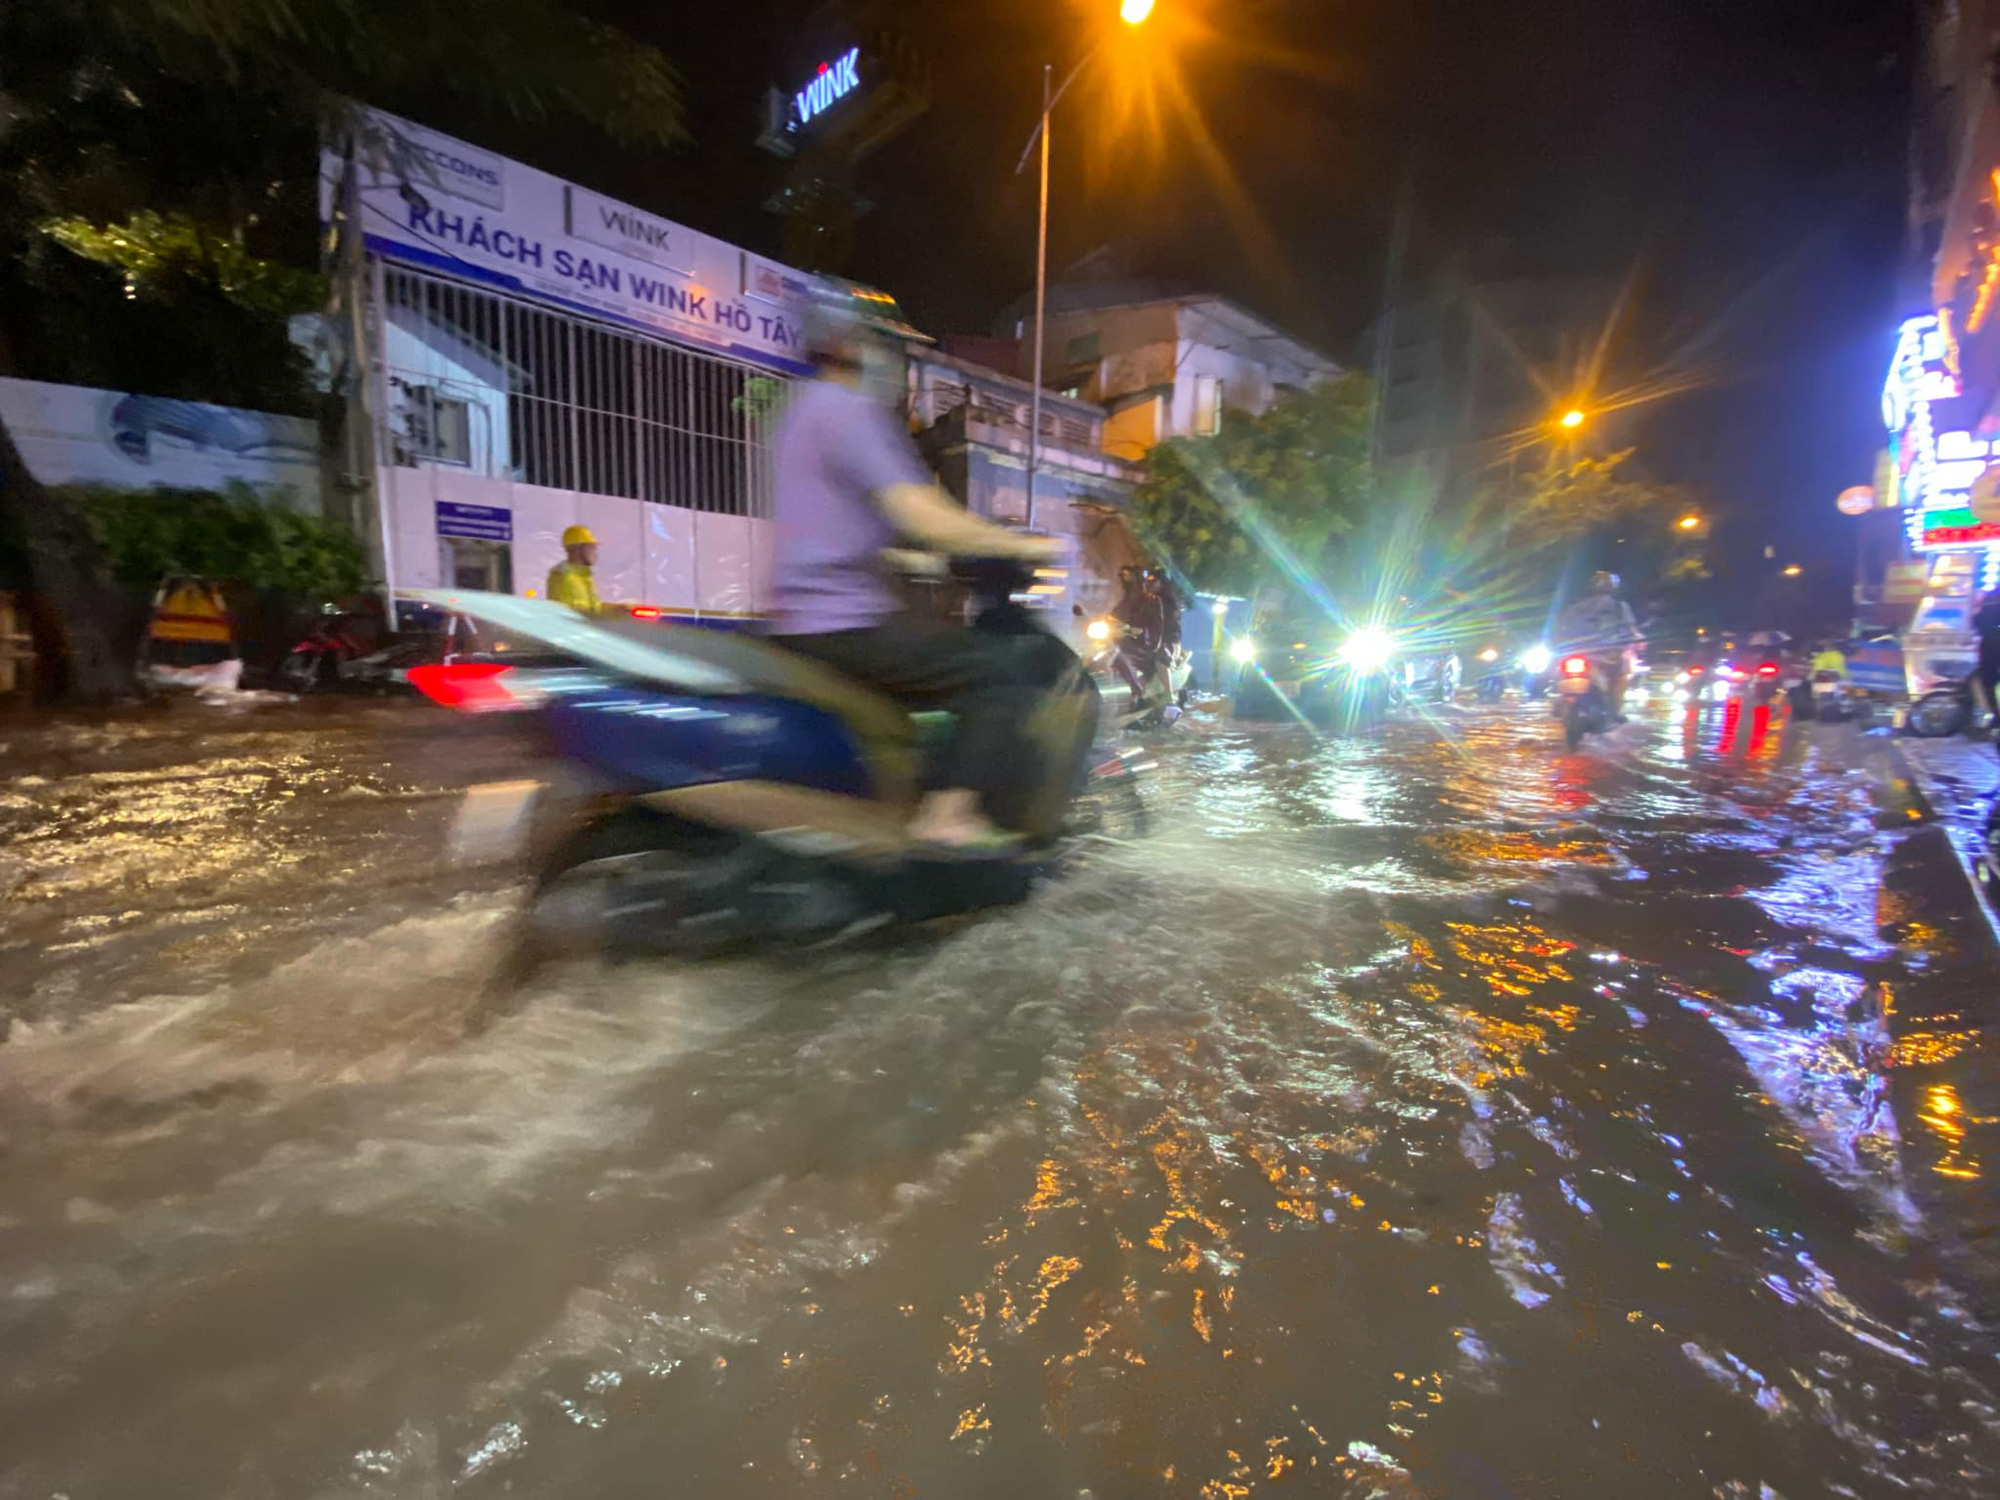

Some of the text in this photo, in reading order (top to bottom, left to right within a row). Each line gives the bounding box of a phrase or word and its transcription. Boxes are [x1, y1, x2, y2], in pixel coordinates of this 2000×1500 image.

[796, 47, 860, 124] WINK
[599, 204, 670, 252] WINK
[409, 203, 542, 268] KHÁCH
[553, 249, 620, 293] SẠN
[628, 272, 706, 320] WINK
[758, 315, 799, 348] TÂY
